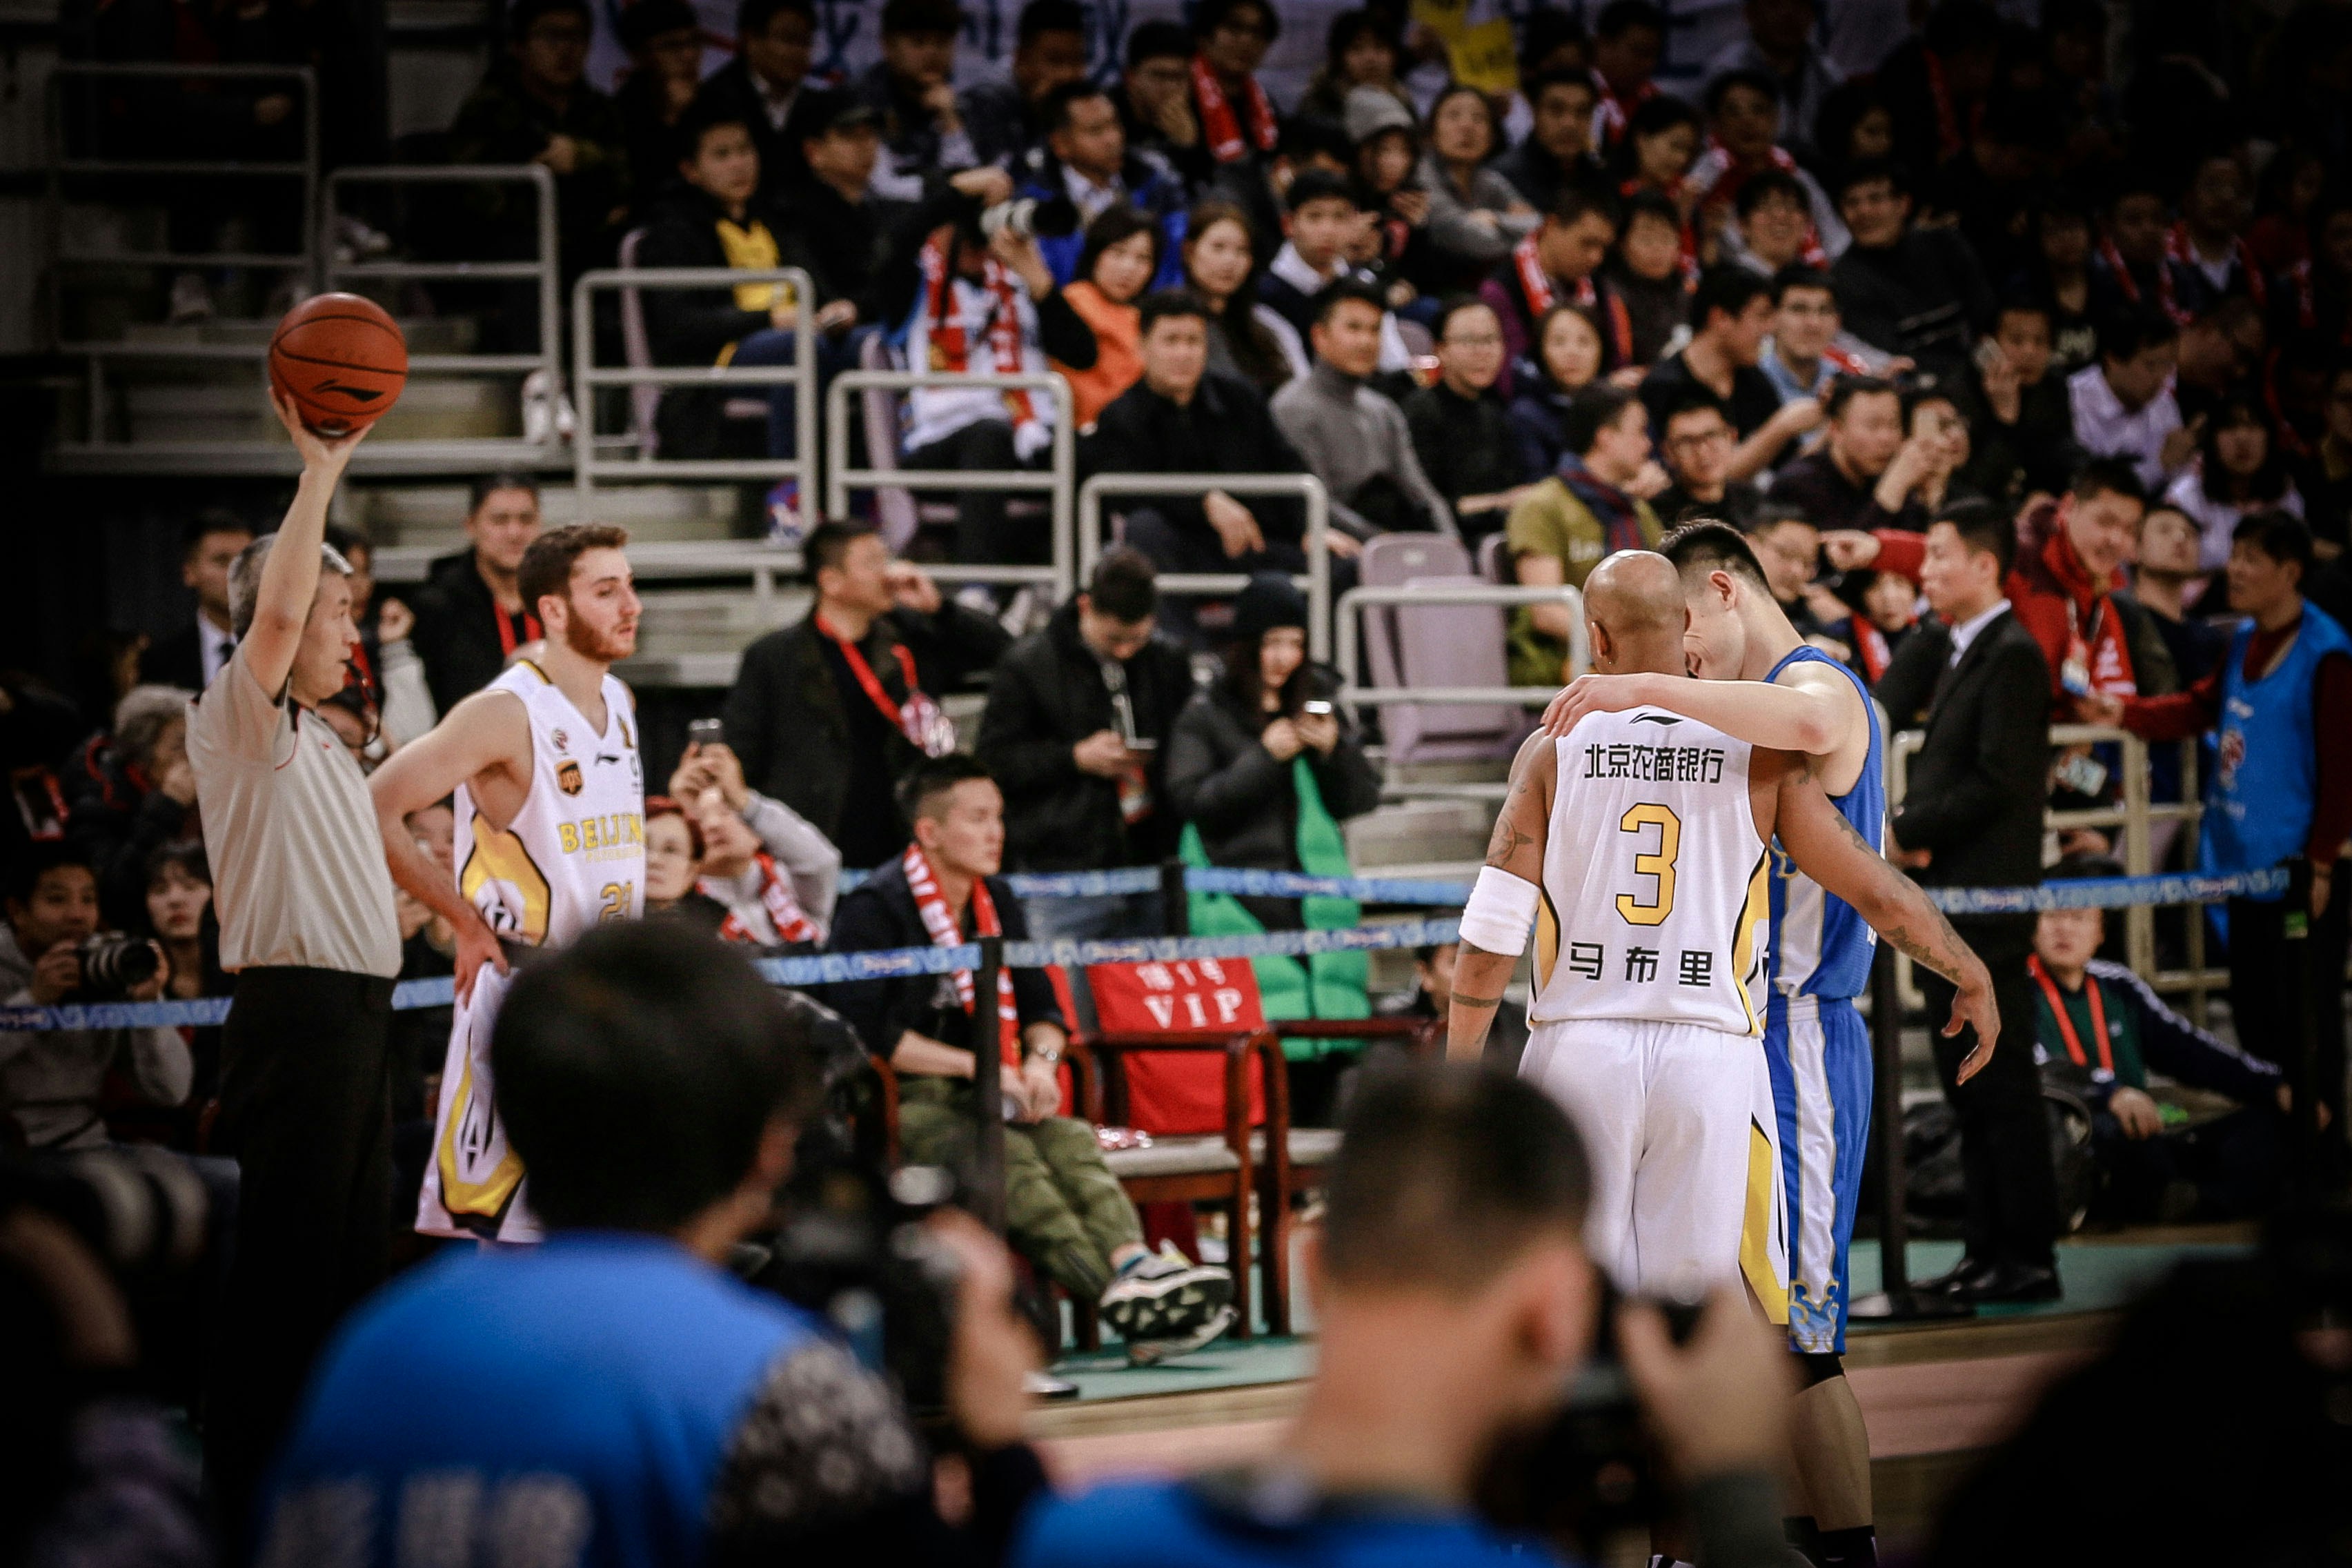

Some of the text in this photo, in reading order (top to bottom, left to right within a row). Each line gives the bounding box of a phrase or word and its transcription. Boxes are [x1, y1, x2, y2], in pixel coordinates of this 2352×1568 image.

[1584, 743, 1724, 784] 北京农商银行
[1616, 803, 1681, 926] 3
[1570, 942, 1712, 986] 马布里
[1143, 987, 1243, 1029] VIP
